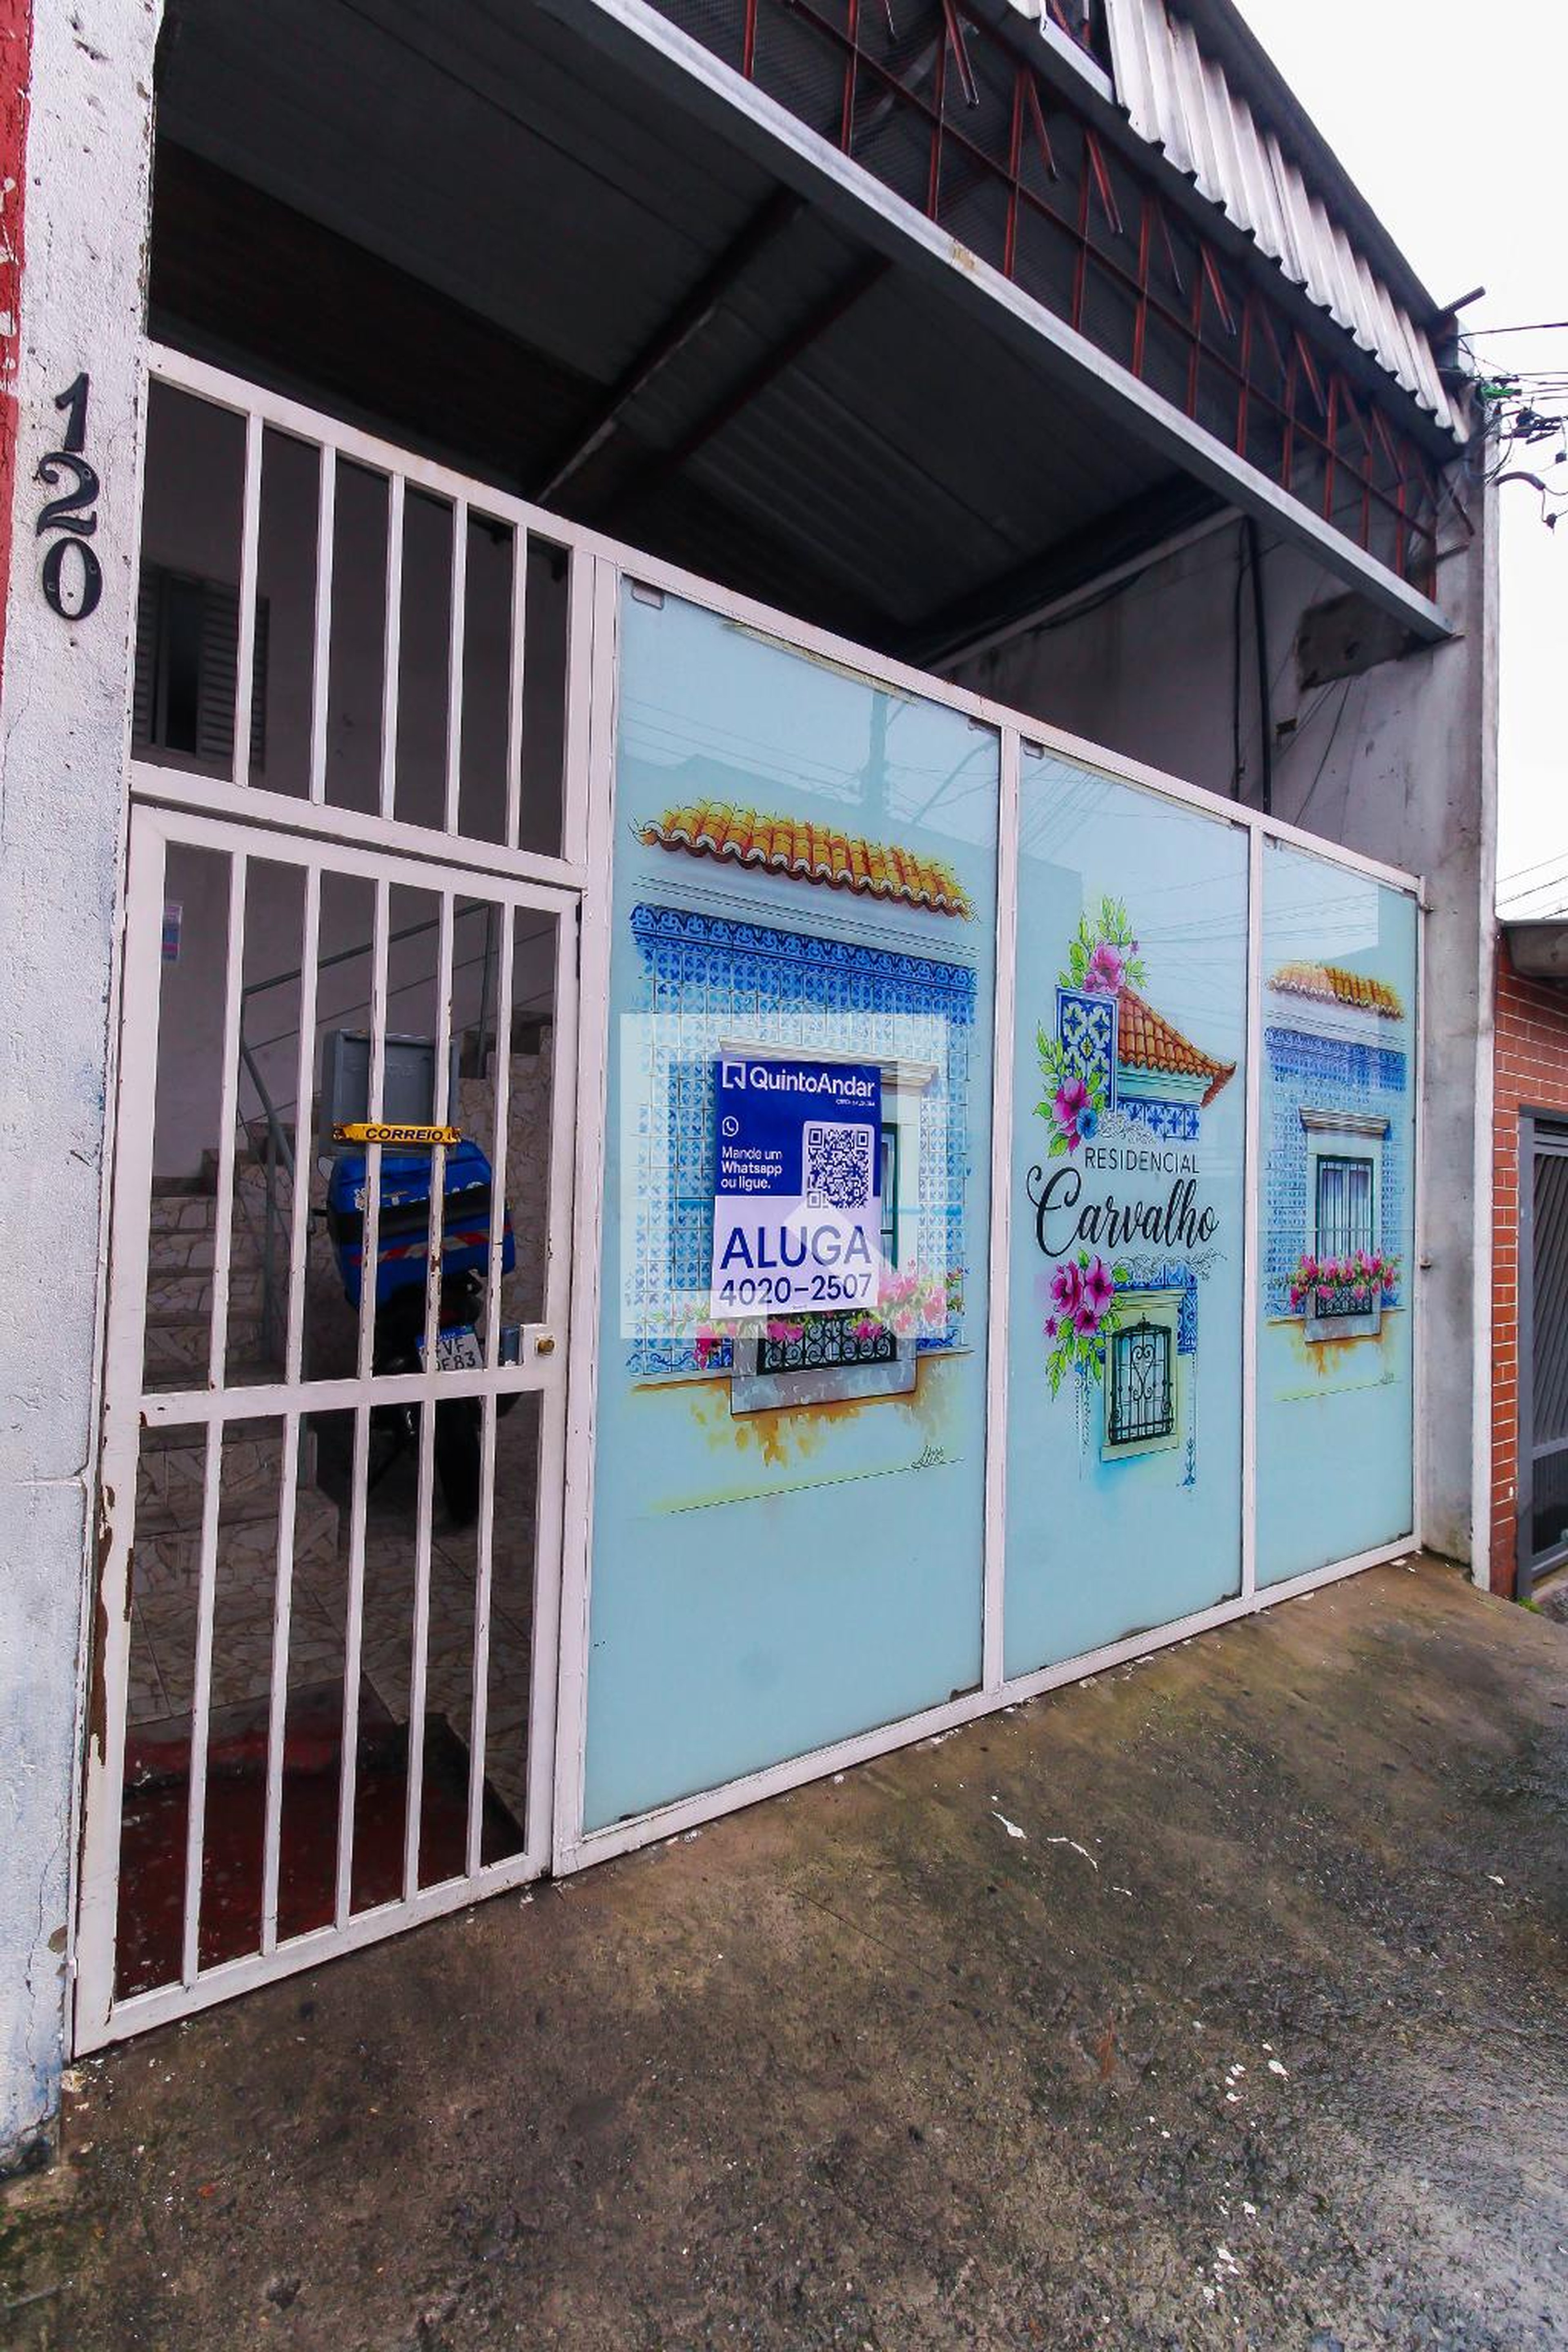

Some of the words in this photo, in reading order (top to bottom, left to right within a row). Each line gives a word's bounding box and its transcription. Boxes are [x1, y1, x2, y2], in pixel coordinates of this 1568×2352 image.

[36, 372, 103, 621] 120
[750, 1066, 875, 1097] QuintoAndar
[365, 1128, 443, 1141] CORREIO
[722, 1145, 762, 1160] Mande
[764, 1150, 783, 1160] um
[1085, 1147, 1200, 1174] RESIDENCIAL
[721, 1160, 783, 1177] Whatsapp
[721, 1178, 737, 1189] ou
[1027, 1165, 1220, 1257] Carvalho
[719, 1226, 871, 1270] ALUGA
[719, 1274, 872, 1307] 4020-2507
